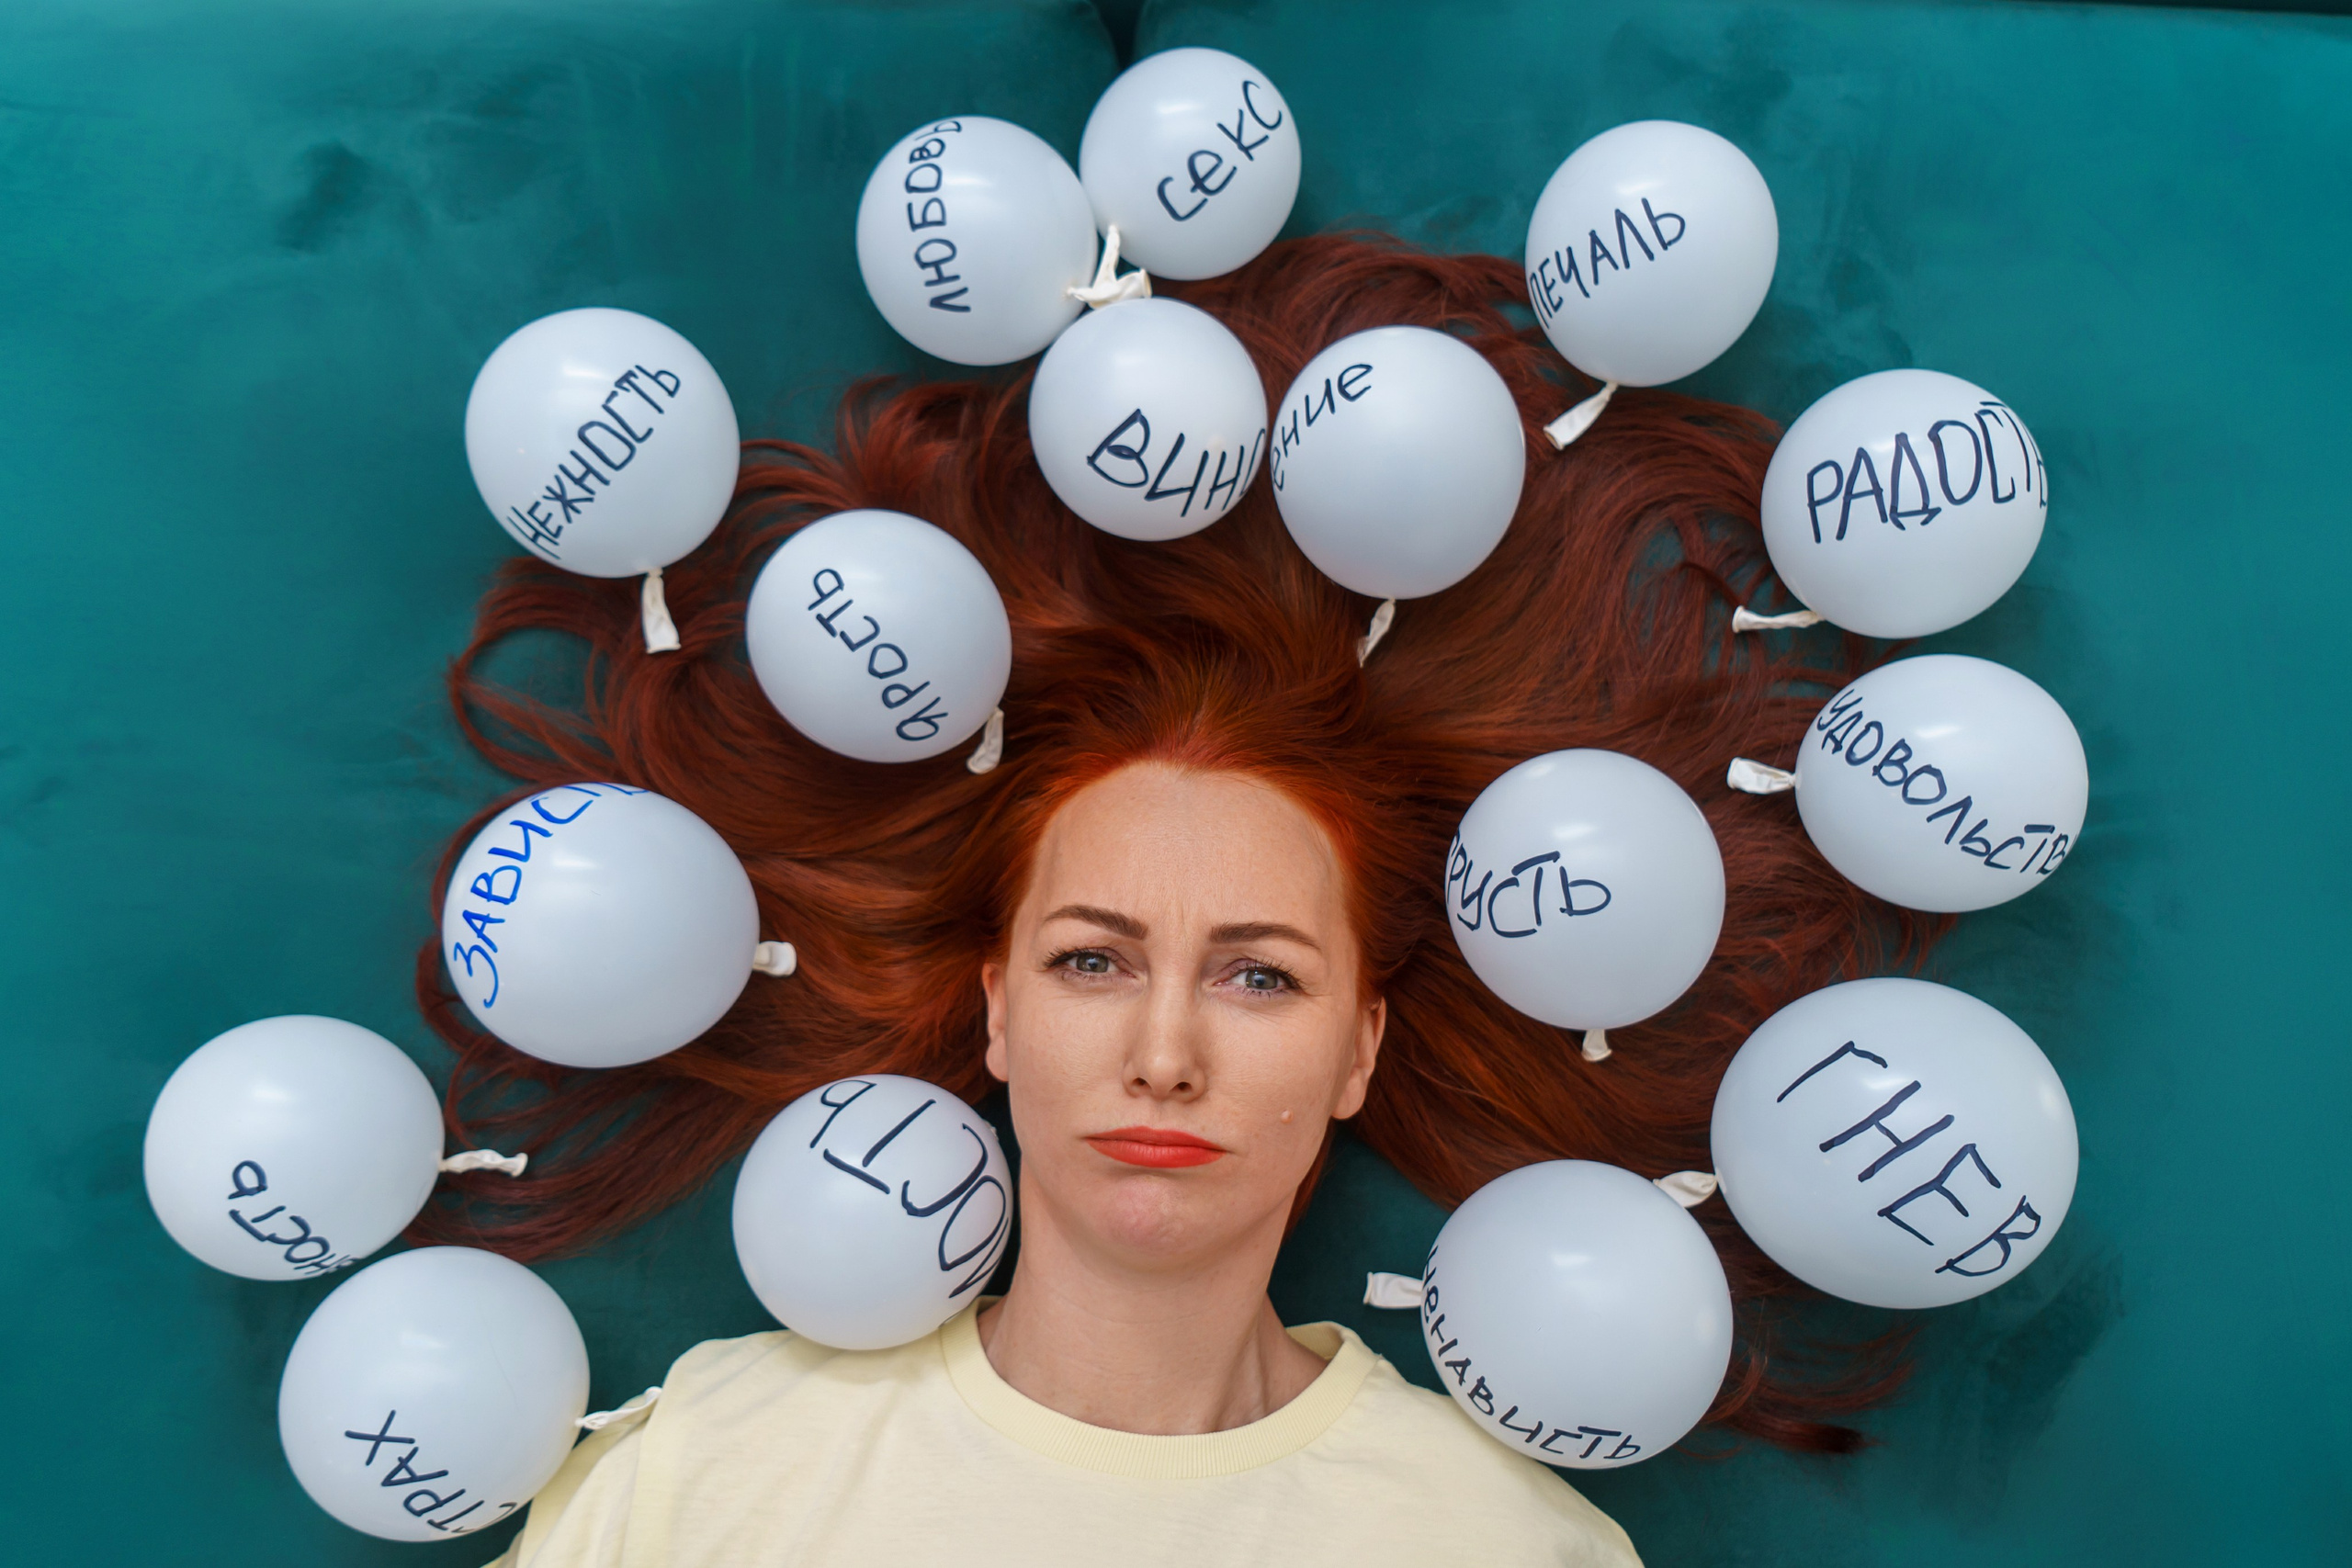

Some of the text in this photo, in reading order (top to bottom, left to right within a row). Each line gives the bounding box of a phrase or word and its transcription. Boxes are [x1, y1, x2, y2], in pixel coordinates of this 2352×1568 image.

[1529, 197, 1687, 329] ПЕЧАЛЬ
[506, 362, 682, 559] НЕЖНОСТЬ
[807, 568, 948, 743] ЯРОСТЬ
[1816, 689, 2078, 875] УДОВОЛЬСТВ
[1778, 1040, 2042, 1278] ГНЕВ
